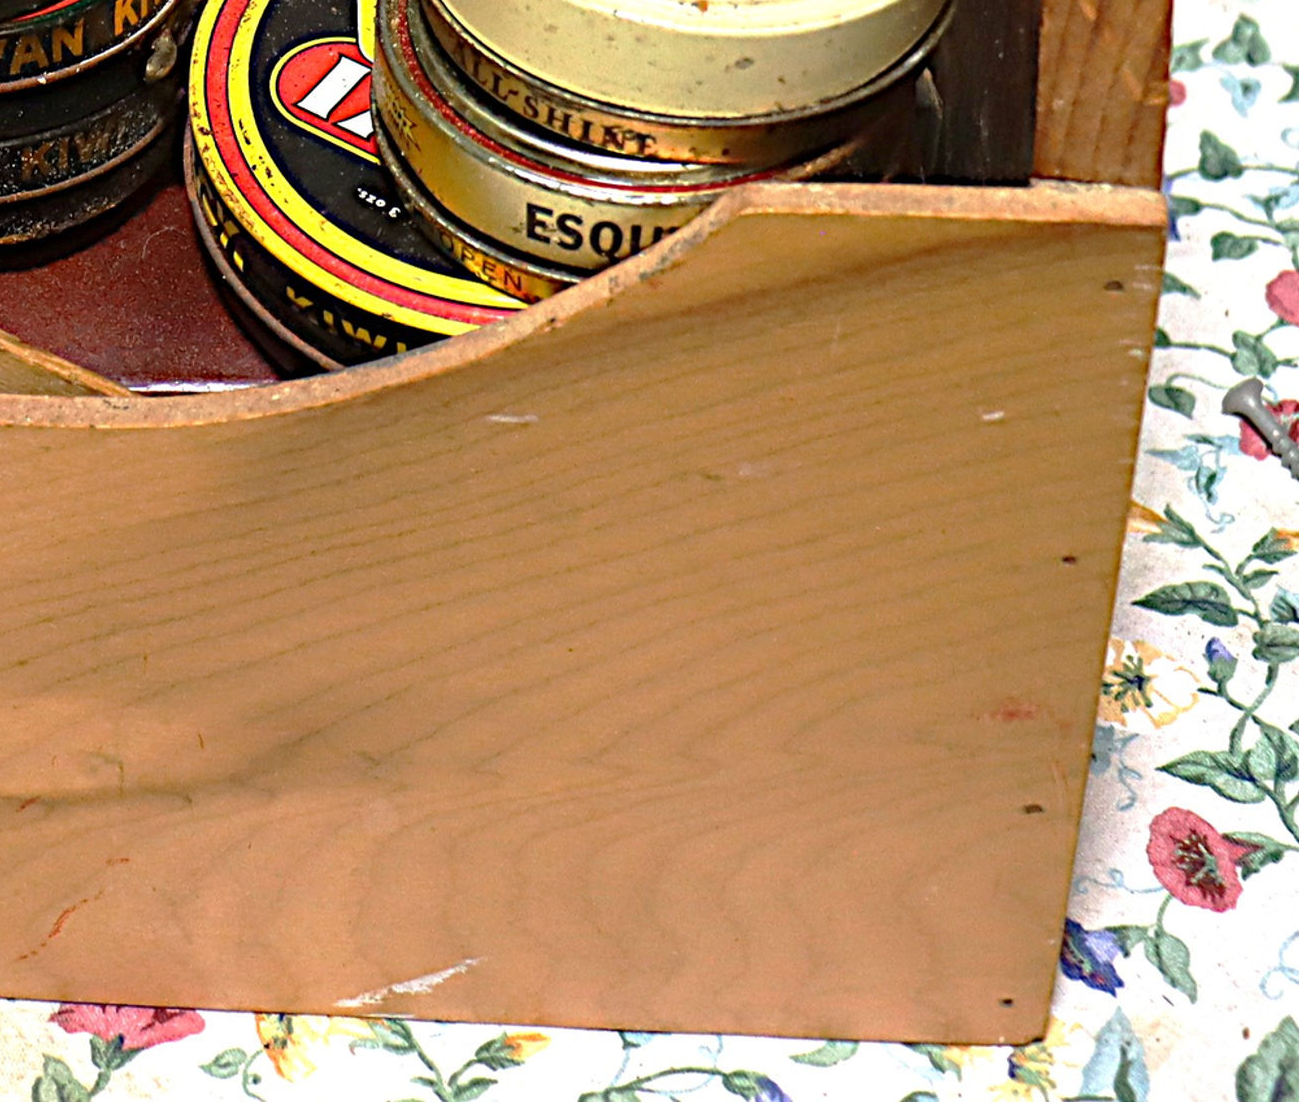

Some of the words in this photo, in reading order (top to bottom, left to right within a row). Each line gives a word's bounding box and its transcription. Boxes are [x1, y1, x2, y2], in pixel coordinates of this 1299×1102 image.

[388, 206, 402, 218] 3
[525, 202, 681, 265] ESQU
[439, 229, 523, 293] OPEN
